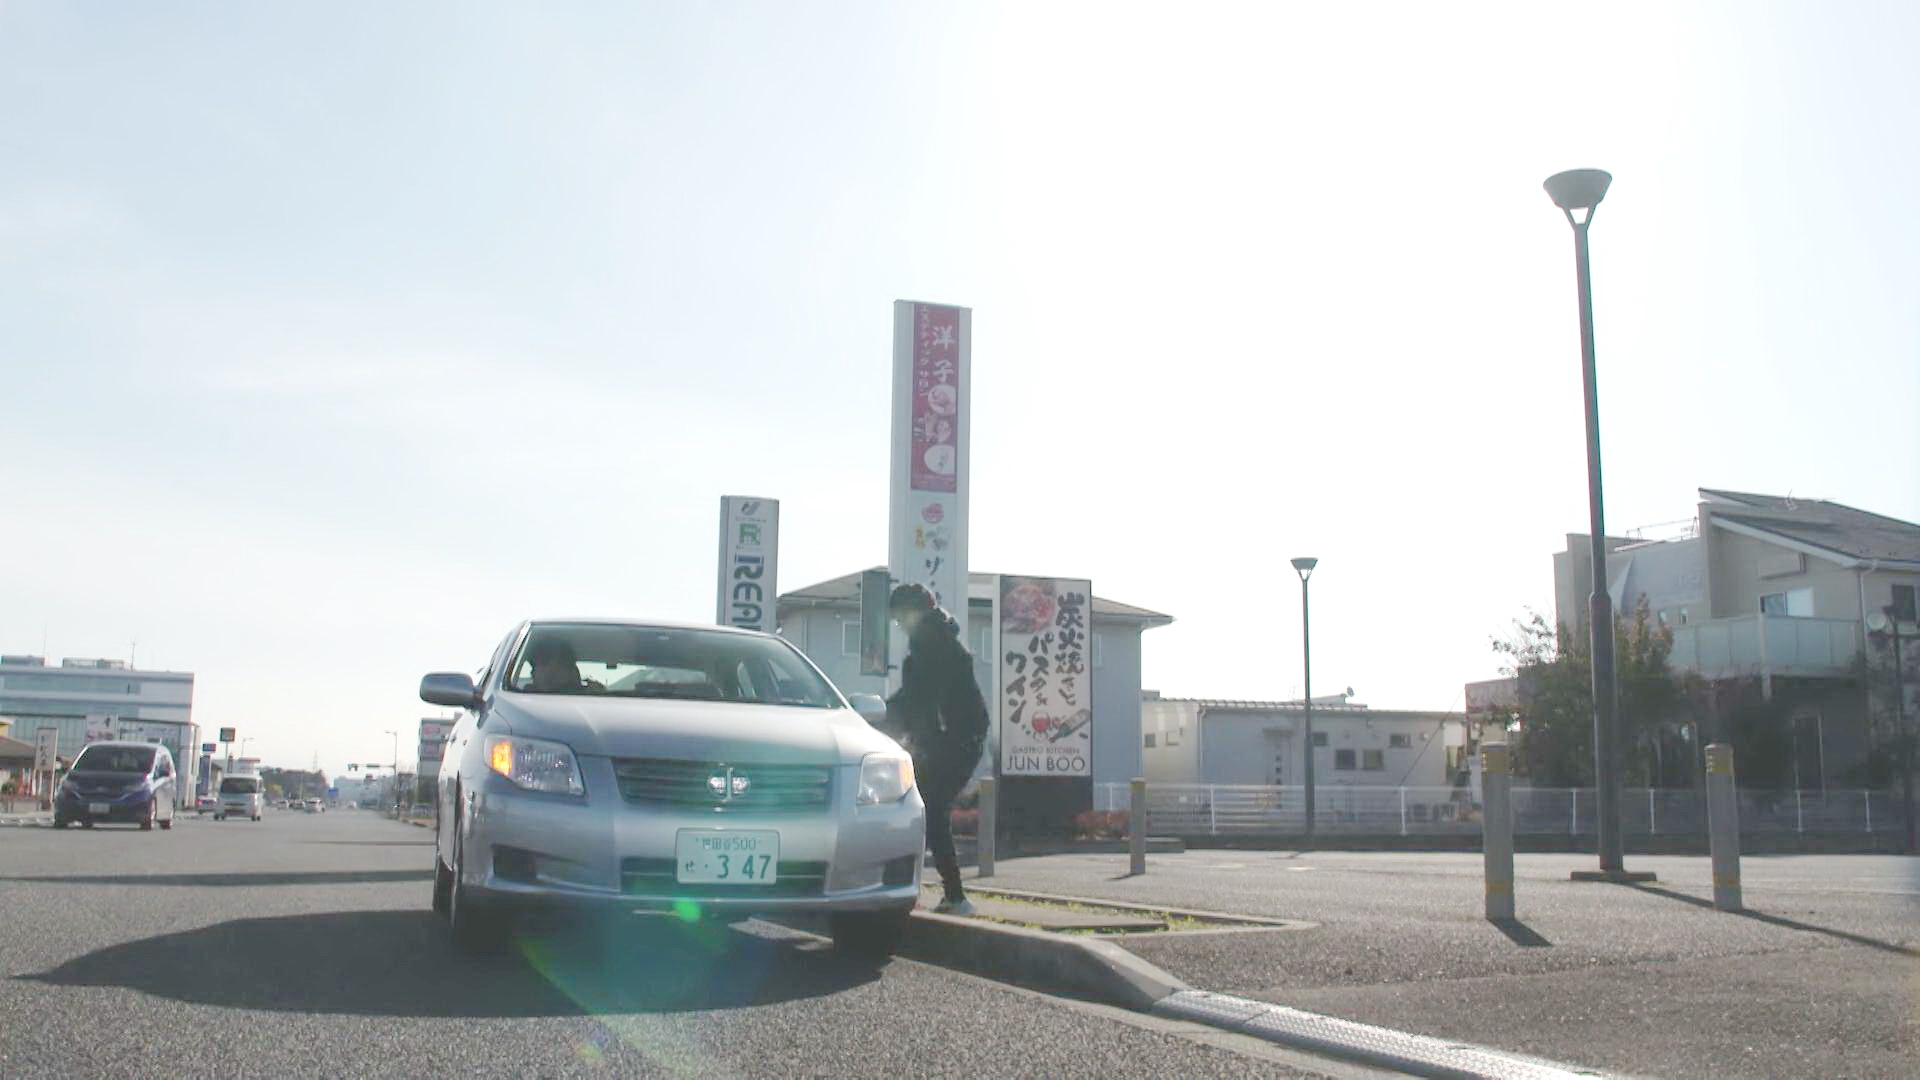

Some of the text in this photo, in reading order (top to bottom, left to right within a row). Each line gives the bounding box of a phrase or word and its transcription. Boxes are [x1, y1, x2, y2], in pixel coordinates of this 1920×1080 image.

[1005, 650, 1027, 724] ワイン
[1007, 755, 1085, 771] JUN BOO
